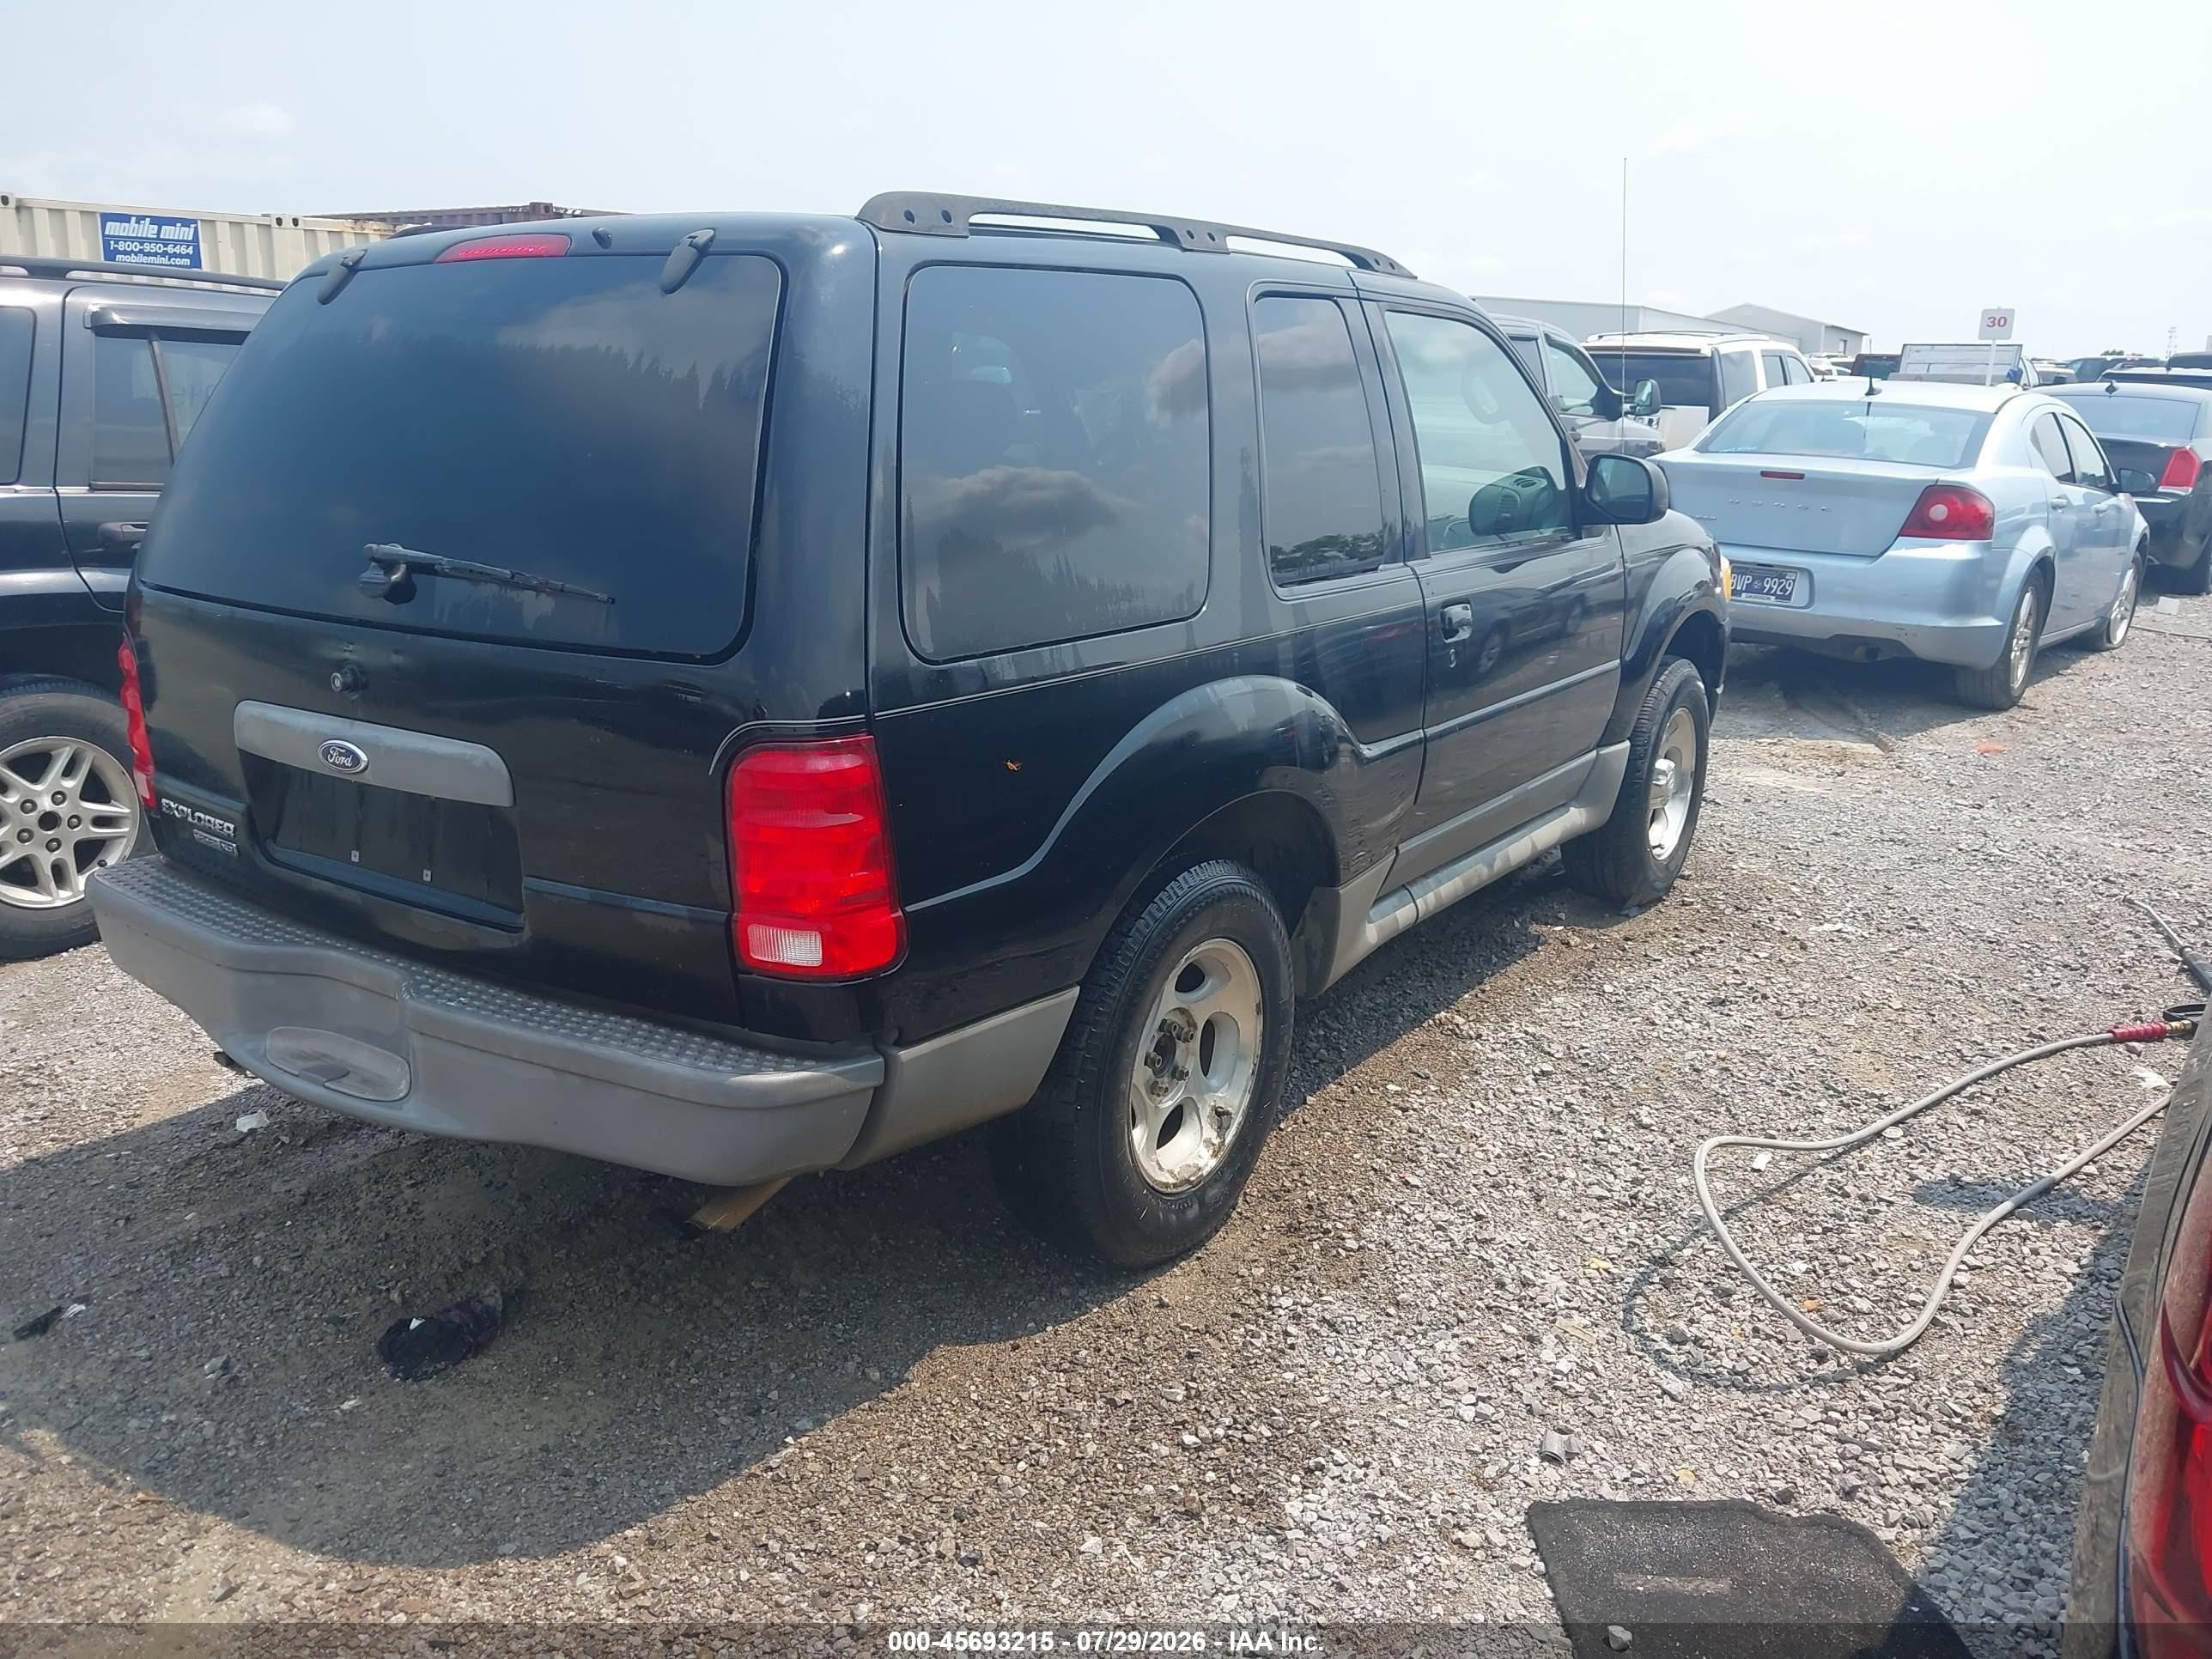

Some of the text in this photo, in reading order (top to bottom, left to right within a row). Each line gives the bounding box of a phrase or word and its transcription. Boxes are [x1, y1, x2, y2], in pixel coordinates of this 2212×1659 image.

[104, 216, 197, 240] mobile mini
[109, 240, 193, 255] 1-800-950-6464
[115, 253, 191, 265] mobilemini.com
[1986, 316, 2007, 327] 30
[1763, 577, 1794, 595] 9929
[327, 746, 353, 767] Ford
[161, 798, 235, 838] EXPLORER
